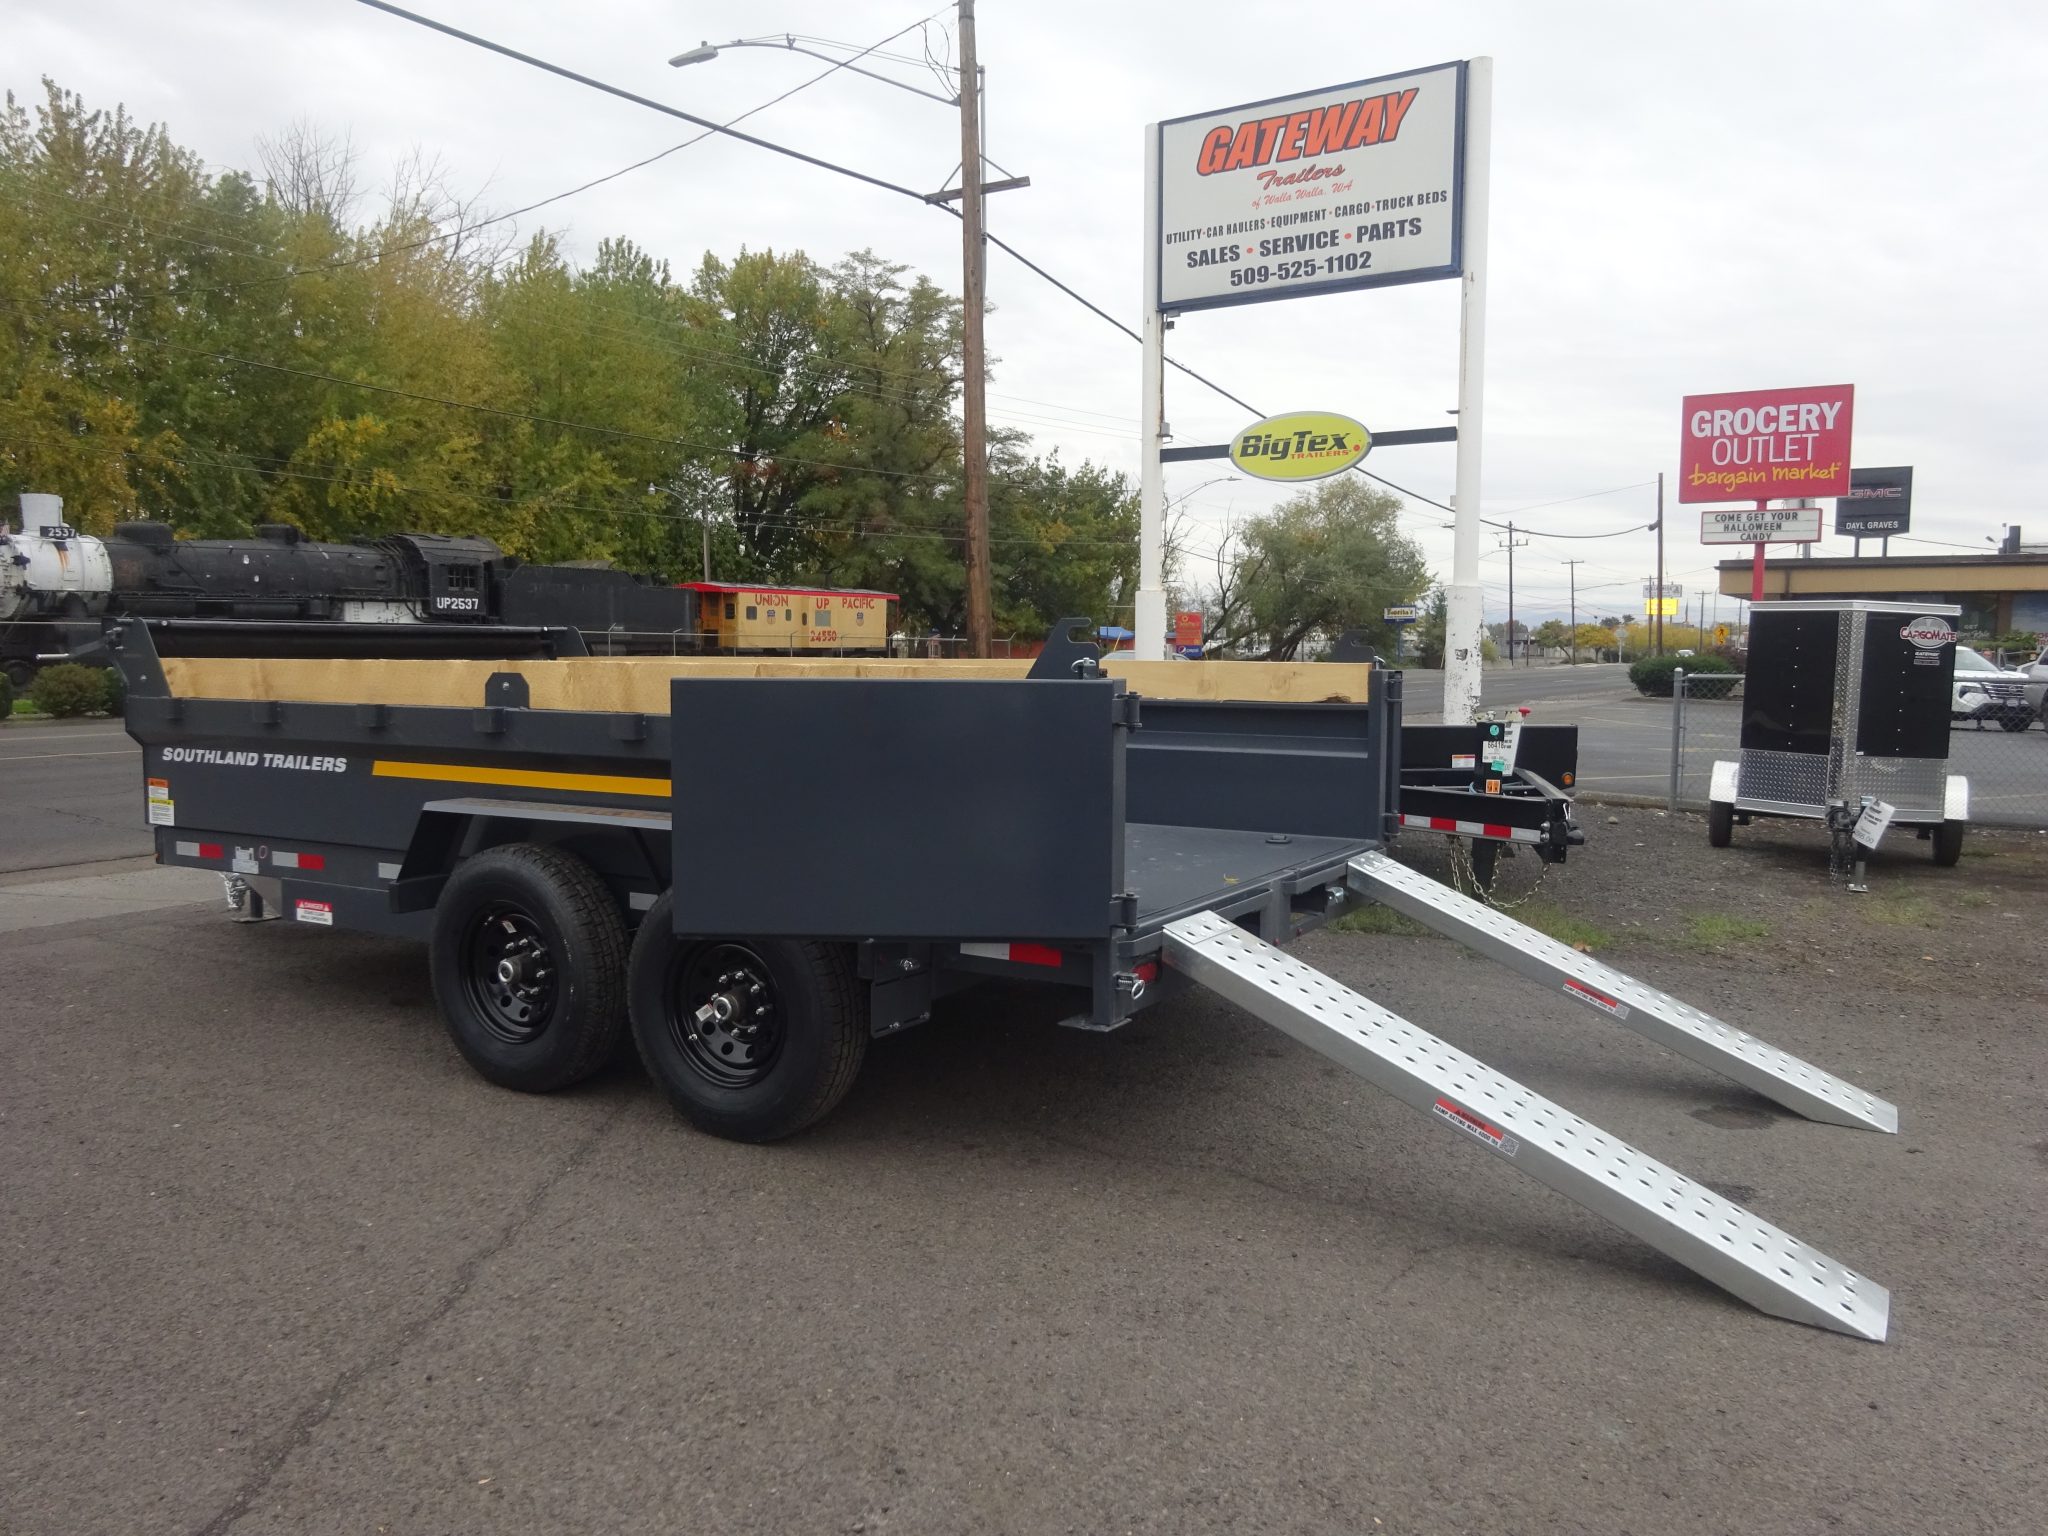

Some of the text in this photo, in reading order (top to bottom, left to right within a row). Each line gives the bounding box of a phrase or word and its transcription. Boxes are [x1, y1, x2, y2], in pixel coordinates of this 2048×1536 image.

[1197, 87, 1420, 176] GATEWAY
[1257, 163, 1346, 190] Trailers
[1251, 197, 1262, 210] of
[1263, 191, 1292, 206] Walla
[1331, 180, 1354, 195] WA
[1166, 189, 1448, 245] UTILITY CAR HAULERS EQUIPMENT CARGO TRUCK BEDS
[1187, 216, 1422, 269] SALES SERVICE PARTS
[1230, 250, 1372, 287] 509-525-1102
[1690, 401, 1843, 438] GROCERY
[1239, 430, 1351, 461] BigTex
[1290, 450, 1350, 460] TRAILERS
[1711, 432, 1820, 466] OUTLET
[1688, 463, 1767, 493] bargain
[1848, 488, 1902, 499] GMC
[1714, 512, 1799, 523] COME GET YOUR
[1723, 522, 1782, 533] HALLOWEEN
[1846, 521, 1899, 530] DAYL GRAVES
[48, 527, 76, 537] 2537
[1740, 532, 1773, 542] CANDY
[436, 597, 479, 611] UP2537
[755, 594, 875, 609] UNION UP PACIFIC
[162, 747, 348, 773] SOUTHLAND TRAILERS
[1433, 1104, 1448, 1116] RAMP
[1448, 1113, 1466, 1126] RATING
[1465, 1123, 1478, 1133] MAX
